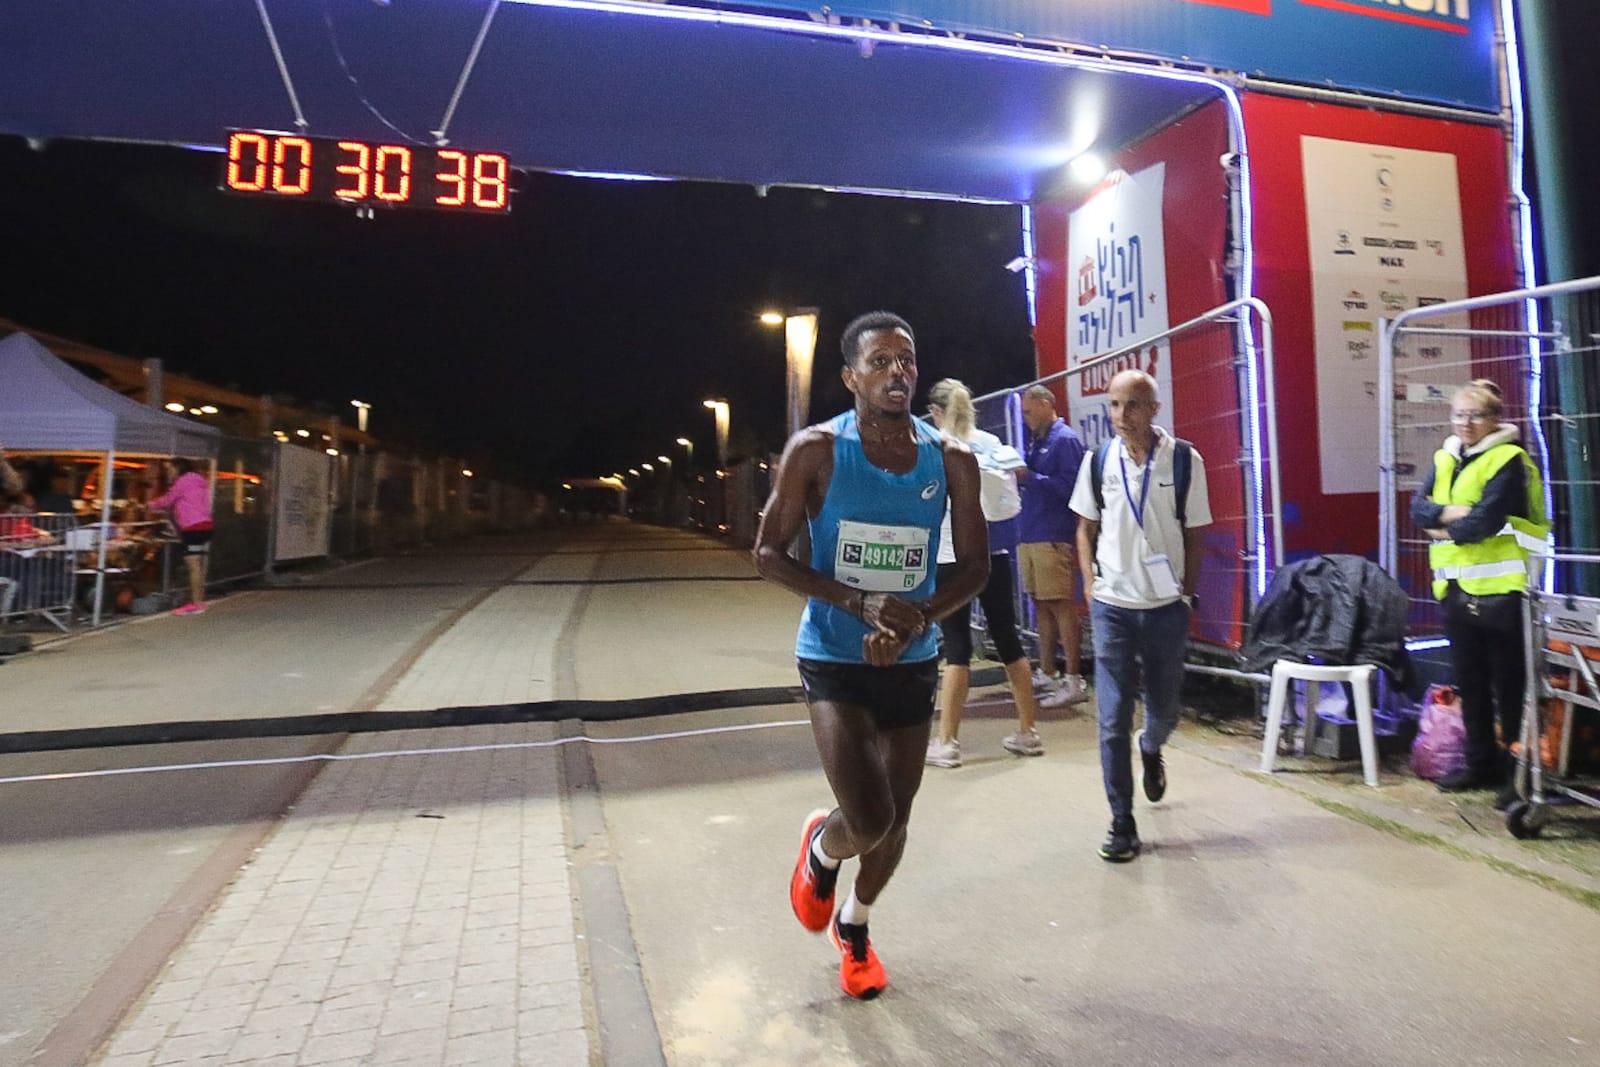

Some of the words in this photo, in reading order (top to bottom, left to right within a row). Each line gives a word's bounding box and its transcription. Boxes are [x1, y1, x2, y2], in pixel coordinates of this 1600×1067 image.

[227, 133, 312, 194] 00
[335, 141, 411, 202] 30
[436, 150, 507, 209] 38
[864, 546, 904, 567] 49142
